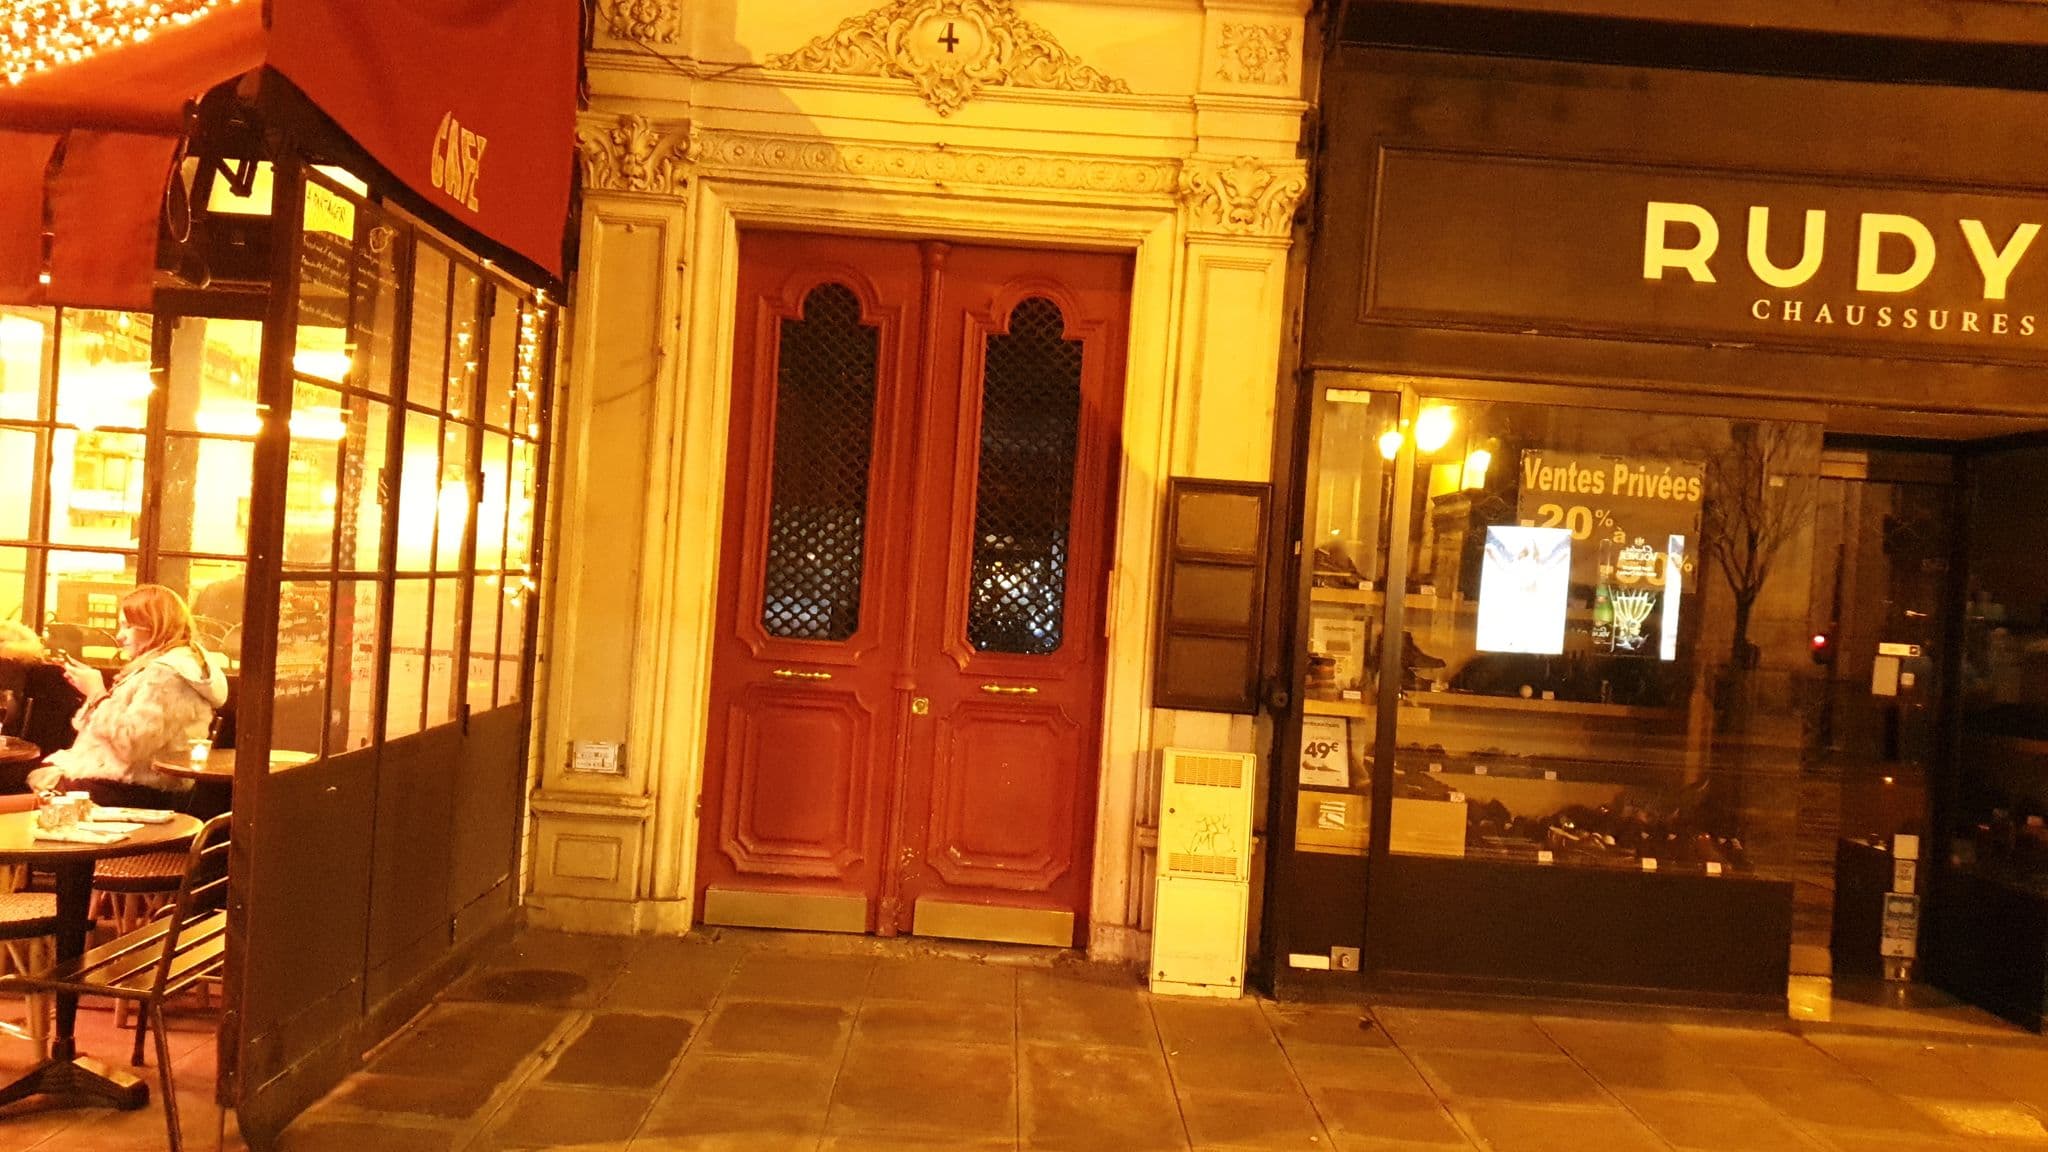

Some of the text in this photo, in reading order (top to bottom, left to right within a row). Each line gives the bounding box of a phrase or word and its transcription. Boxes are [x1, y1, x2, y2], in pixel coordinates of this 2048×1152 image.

[937, 22, 959, 53] 4
[1643, 201, 2042, 300] RUDY
[1751, 299, 2036, 336] CHAUSSURES
[1524, 457, 1701, 502] Ventes Privées
[1613, 527, 1626, 544] à
[1304, 741, 1340, 759] 49€
